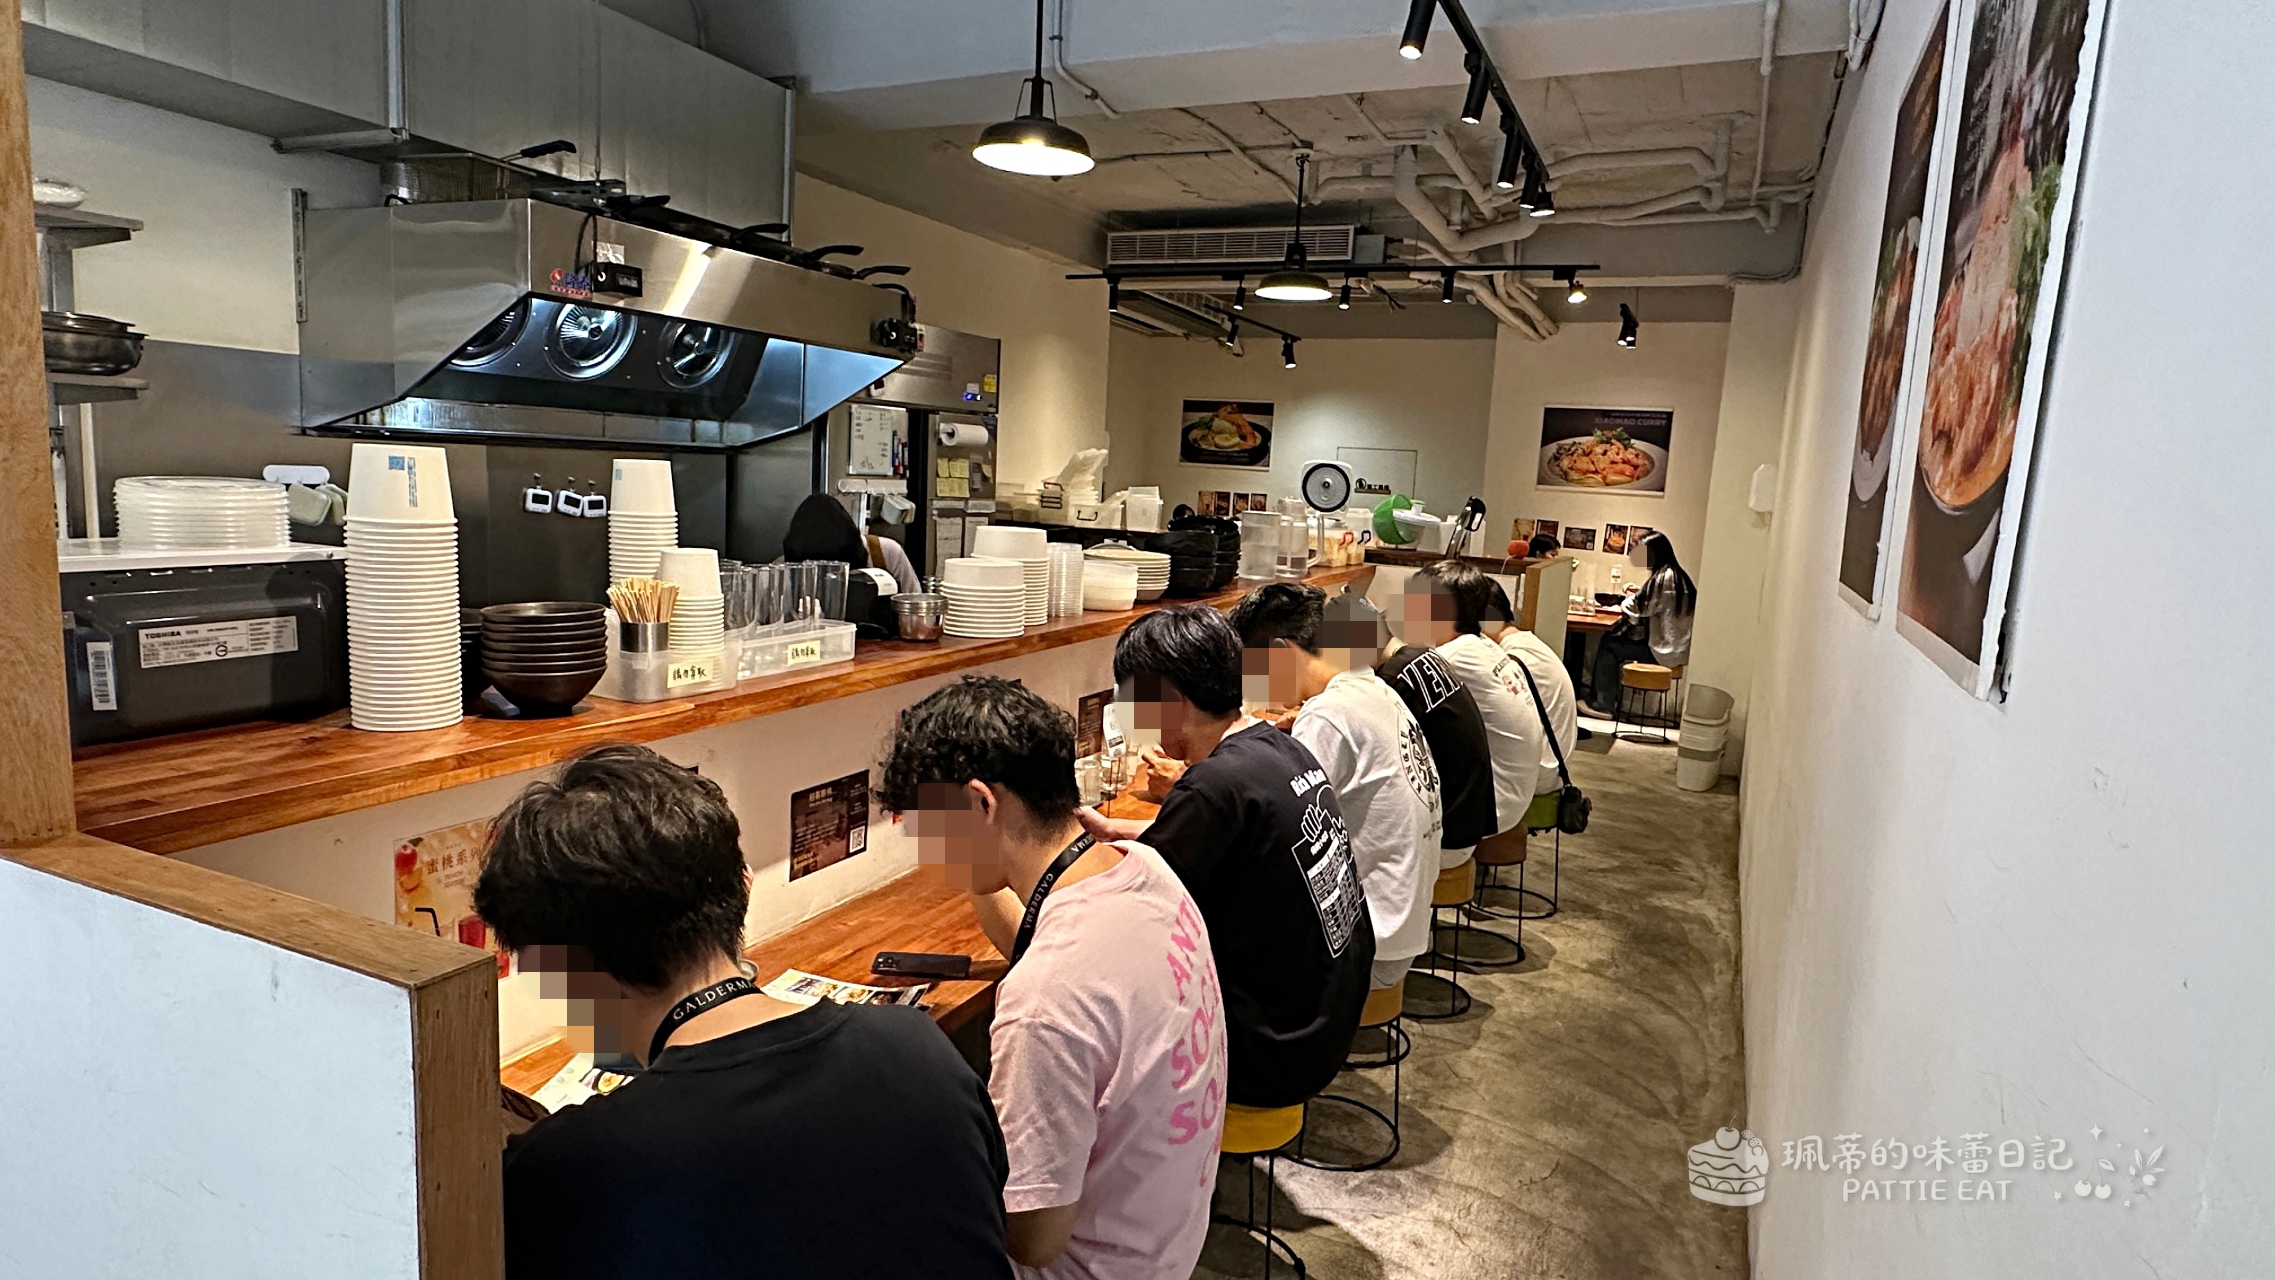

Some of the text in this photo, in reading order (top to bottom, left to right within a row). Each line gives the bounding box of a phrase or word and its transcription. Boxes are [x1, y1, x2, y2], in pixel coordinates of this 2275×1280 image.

[1637, 418, 1668, 427] CURRY
[145, 630, 181, 640] TOSHIBA
[1021, 872, 1055, 931] GALDERMA
